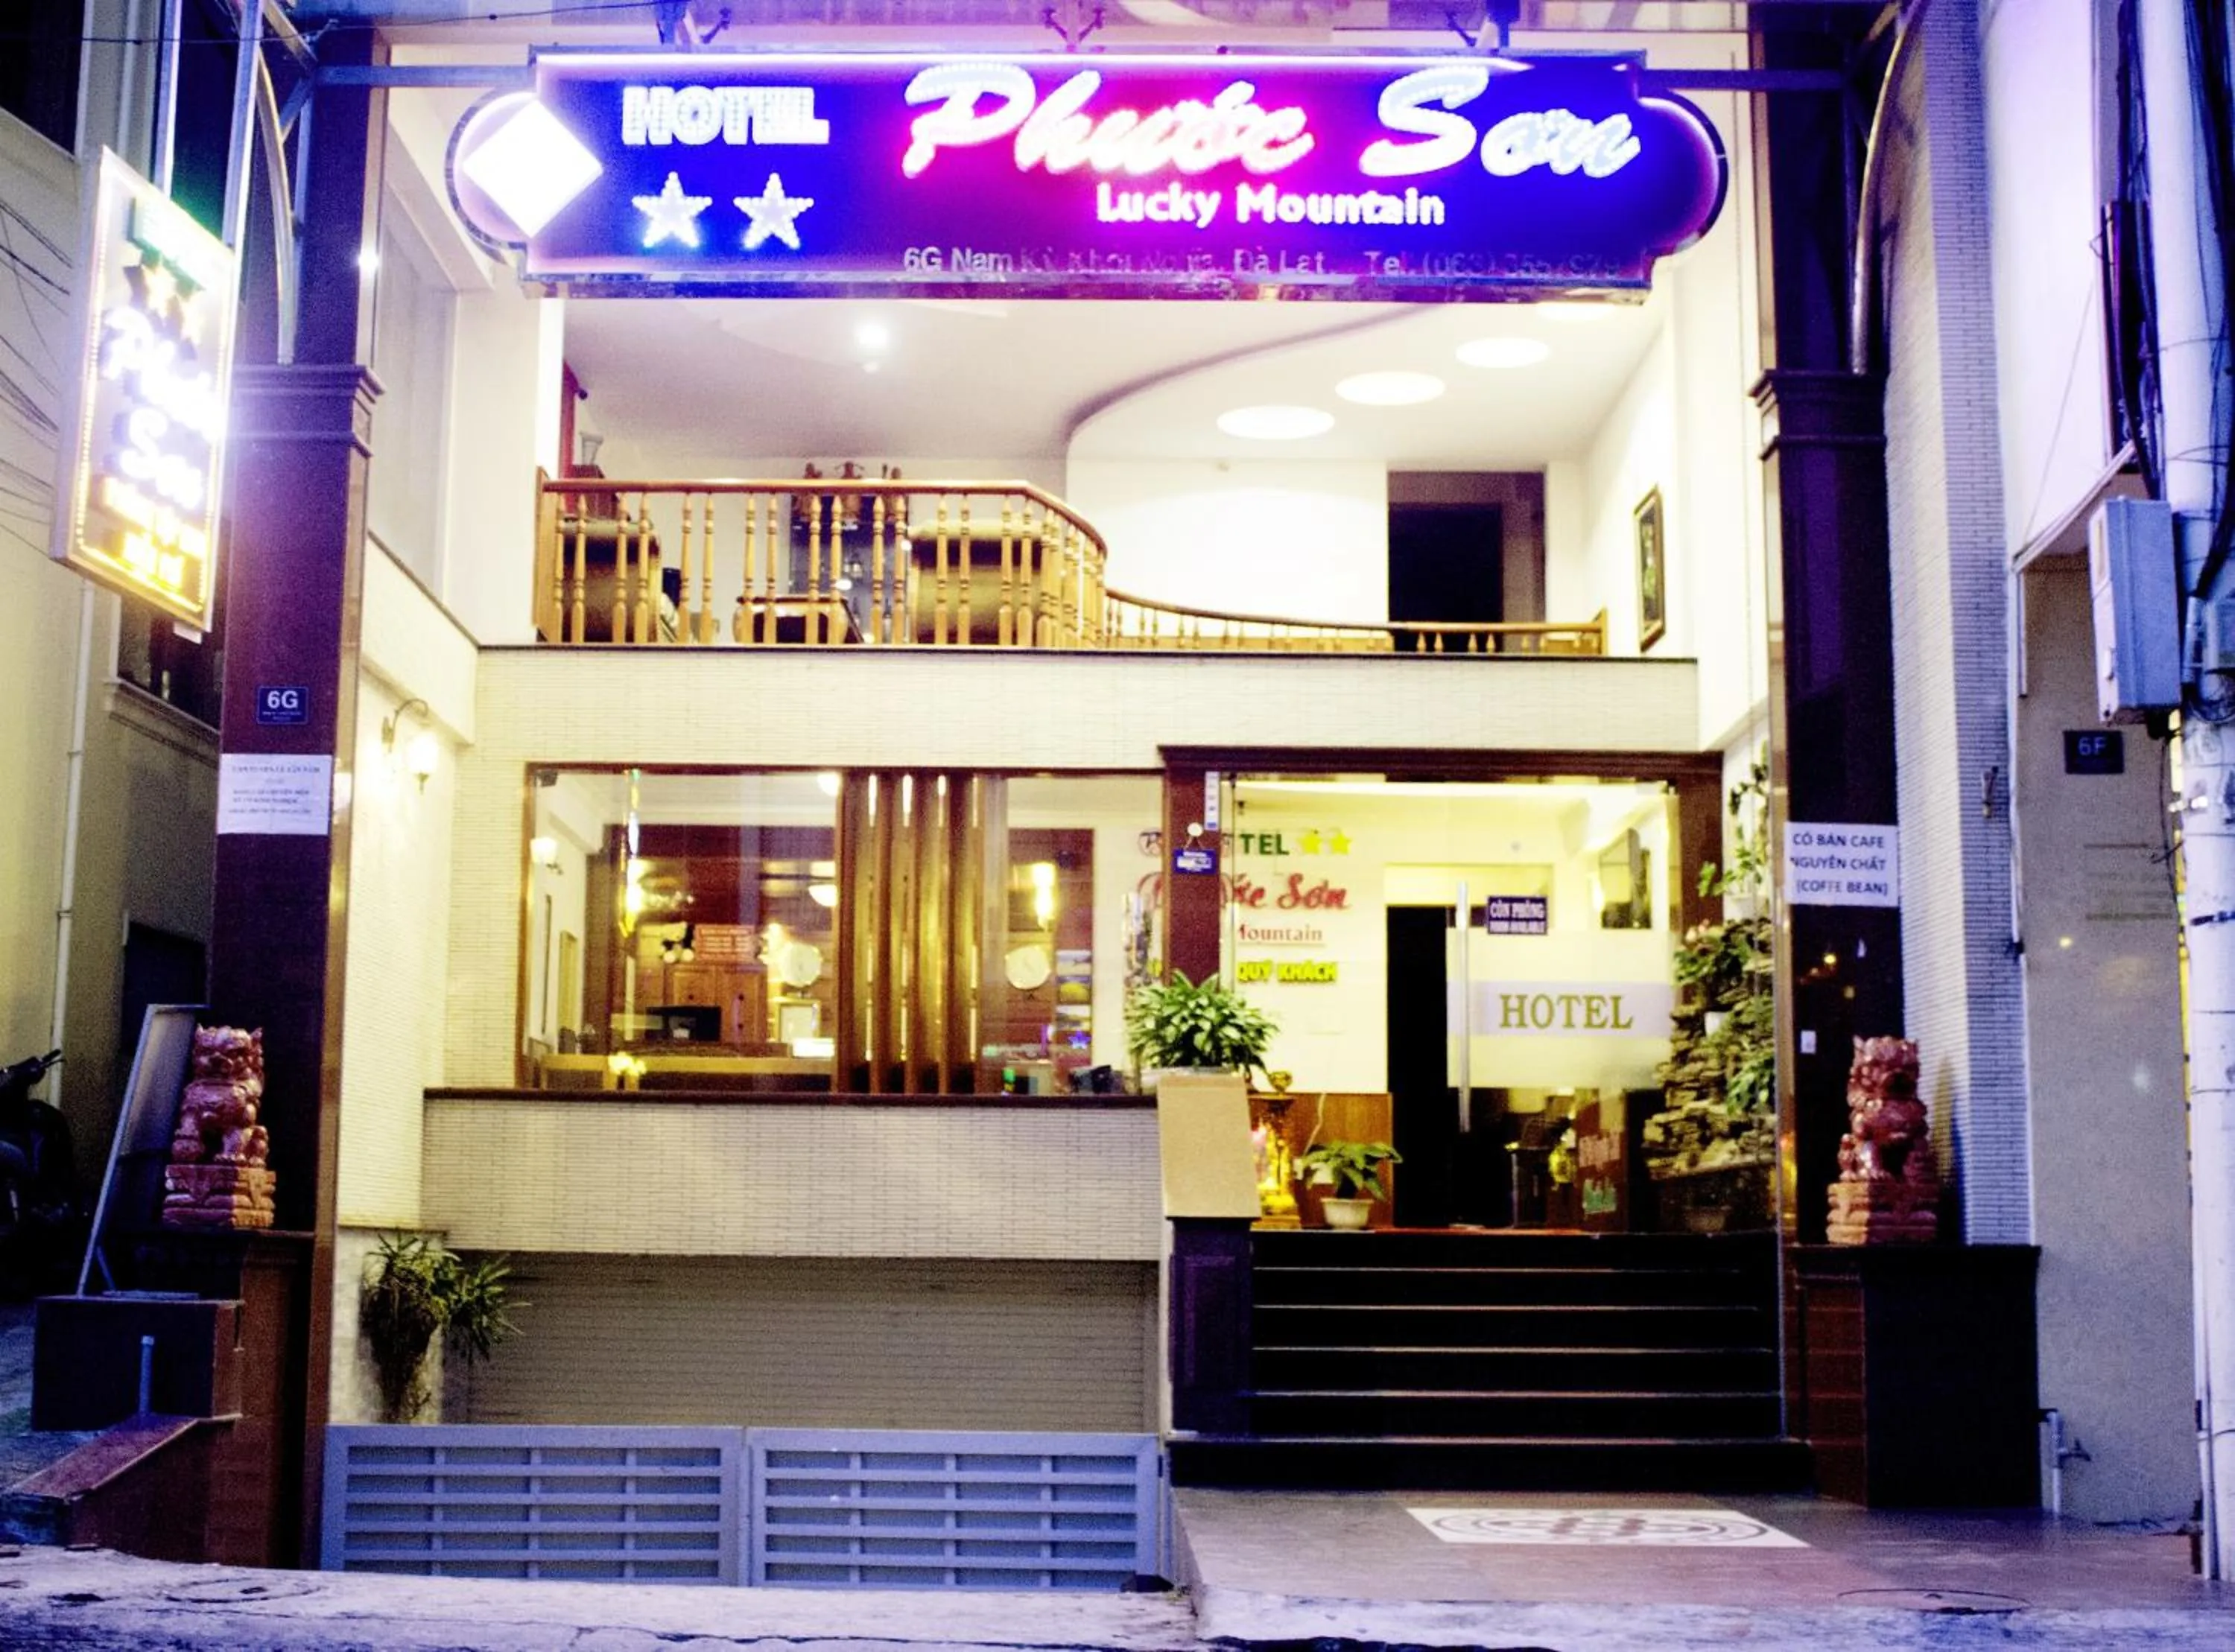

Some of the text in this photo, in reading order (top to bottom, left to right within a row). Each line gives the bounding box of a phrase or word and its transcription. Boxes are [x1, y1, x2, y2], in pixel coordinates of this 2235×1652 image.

[622, 86, 830, 145] HOTEL
[1097, 182, 1445, 229] Lucky Mountain
[904, 247, 942, 273] 6G
[951, 247, 1012, 273] Nam
[267, 690, 299, 708] 6G
[2078, 736, 2107, 755] 6F
[1792, 831, 1813, 846] CÓ
[1850, 835, 1884, 848] CAFE
[1499, 993, 1634, 1029] HOTEL
